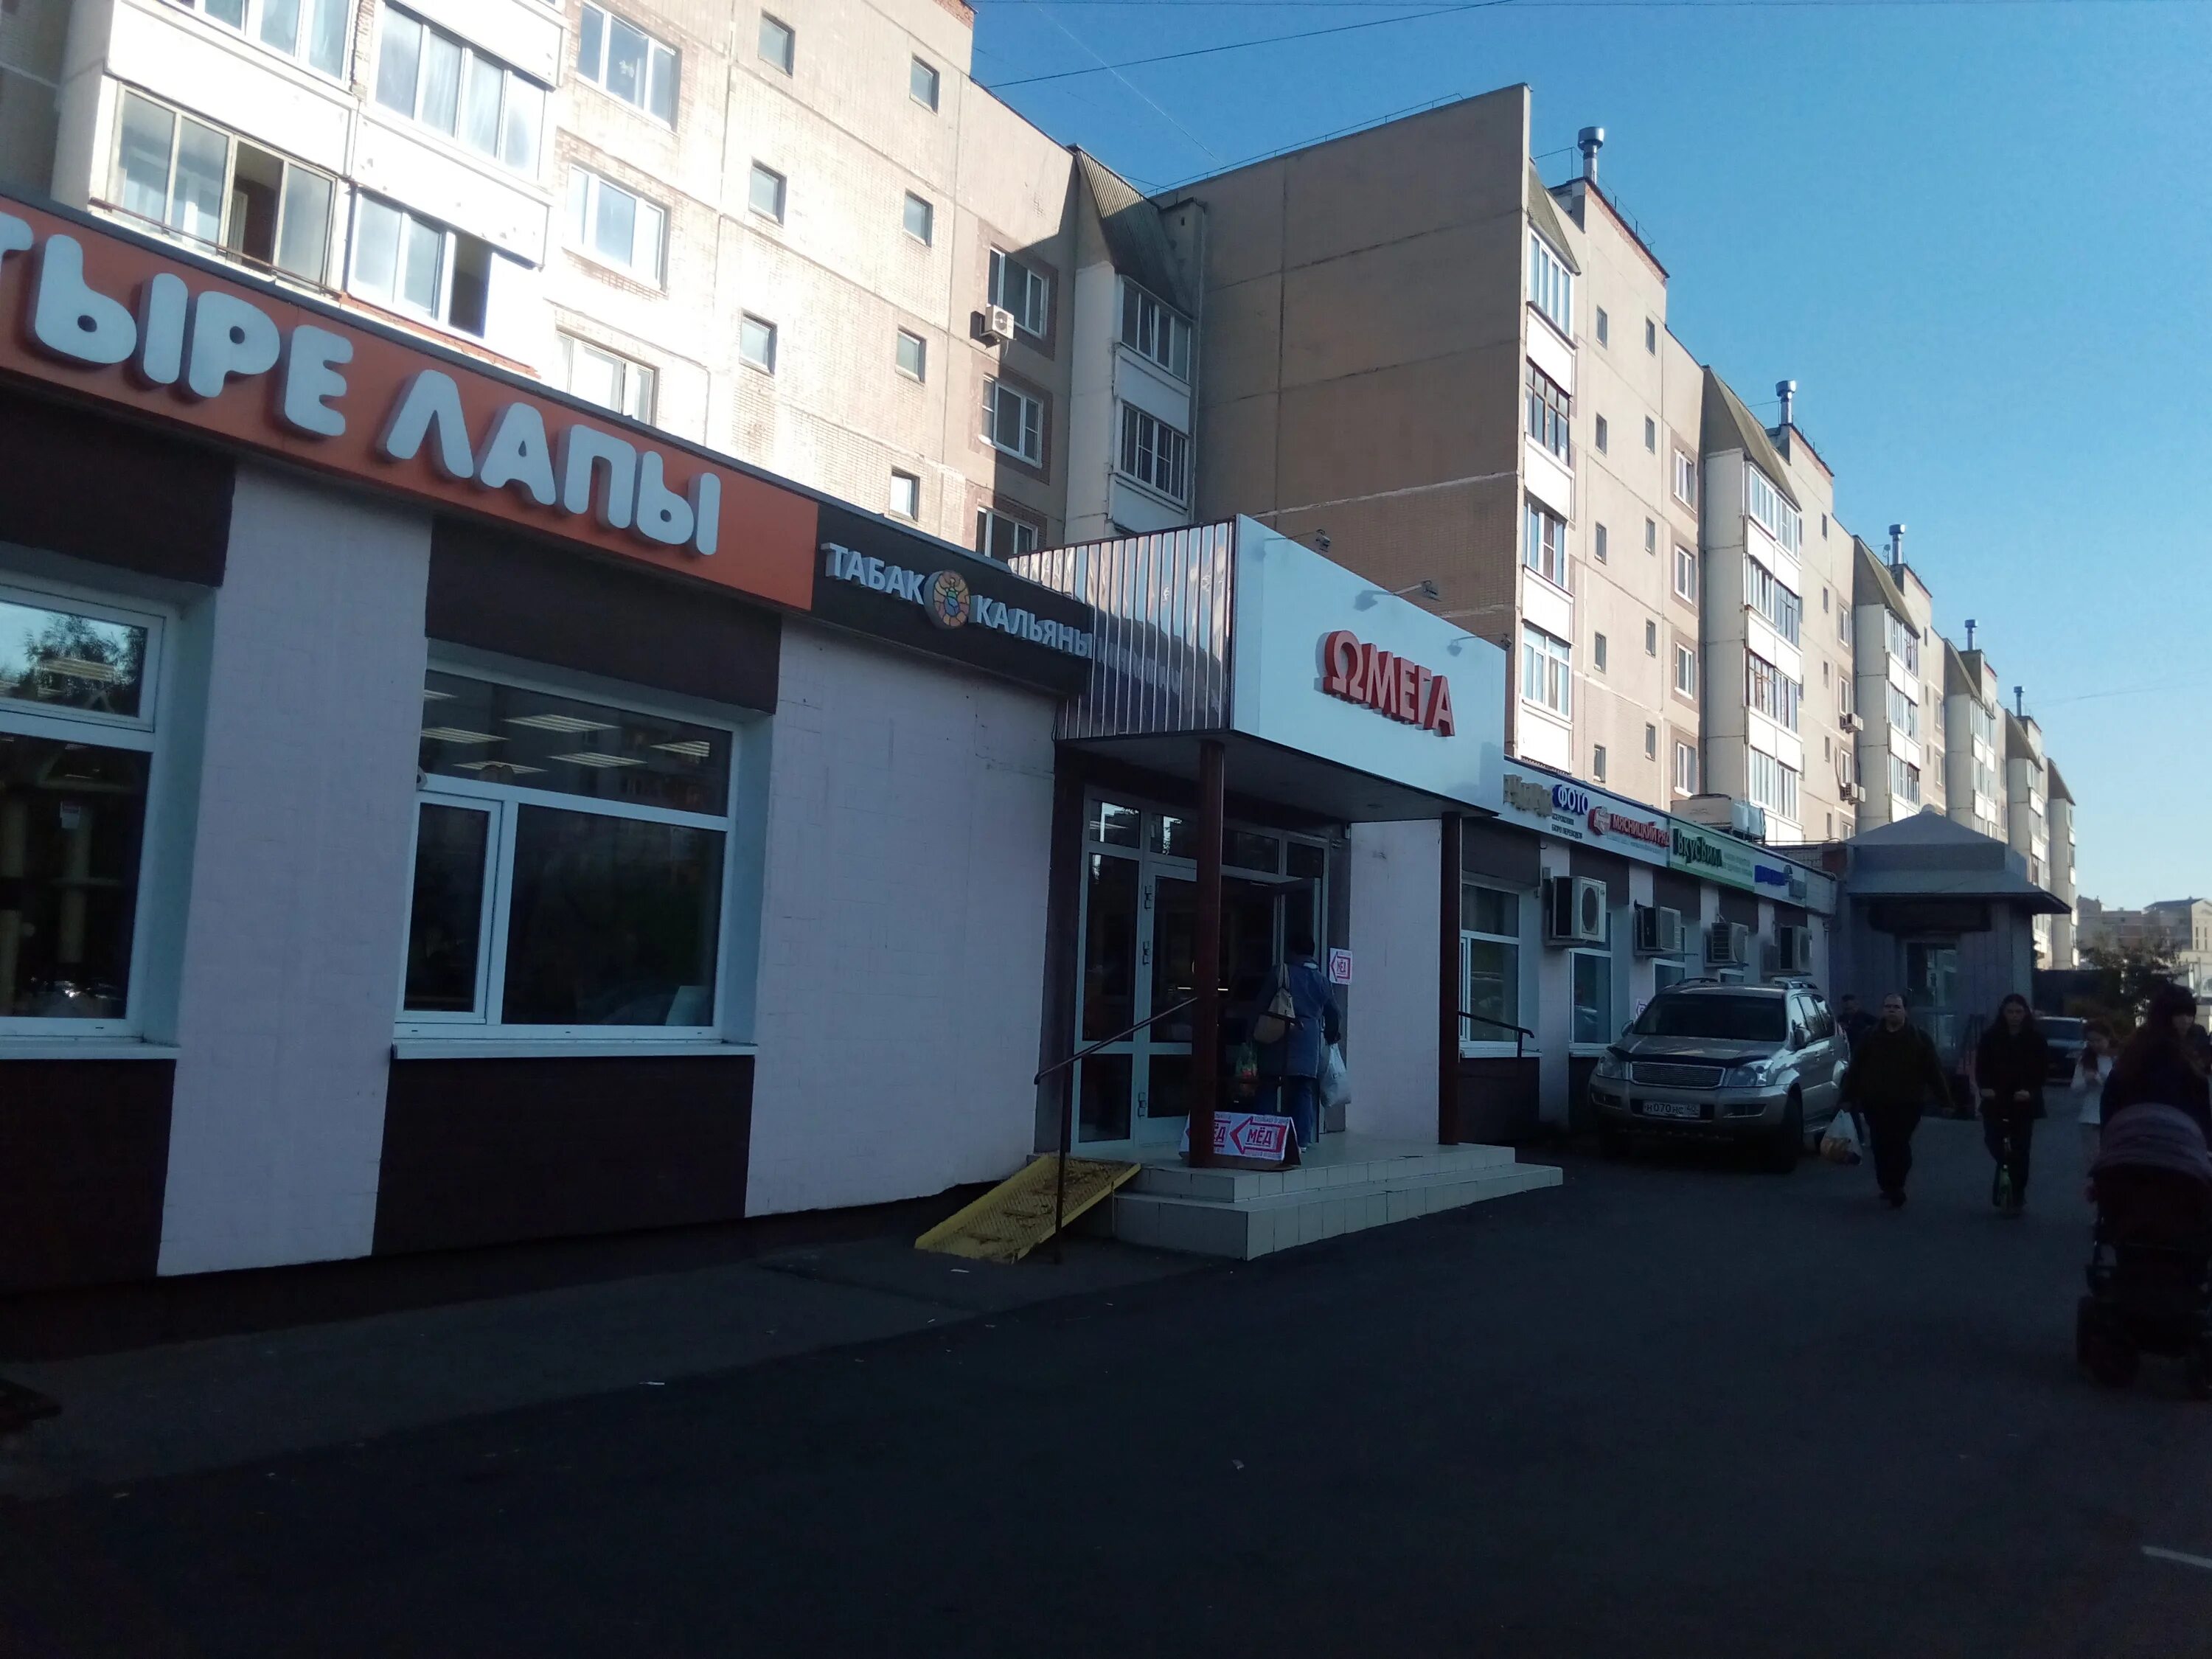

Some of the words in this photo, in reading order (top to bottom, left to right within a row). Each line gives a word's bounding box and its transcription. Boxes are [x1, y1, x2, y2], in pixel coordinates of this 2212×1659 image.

[382, 369, 720, 556] ЛАПЫ
[821, 542, 925, 605] ТАБАК
[970, 594, 1093, 658] КАЛЬЯНЫ
[1554, 785, 1589, 815] ФОТО
[1247, 1127, 1273, 1146] МЁД
